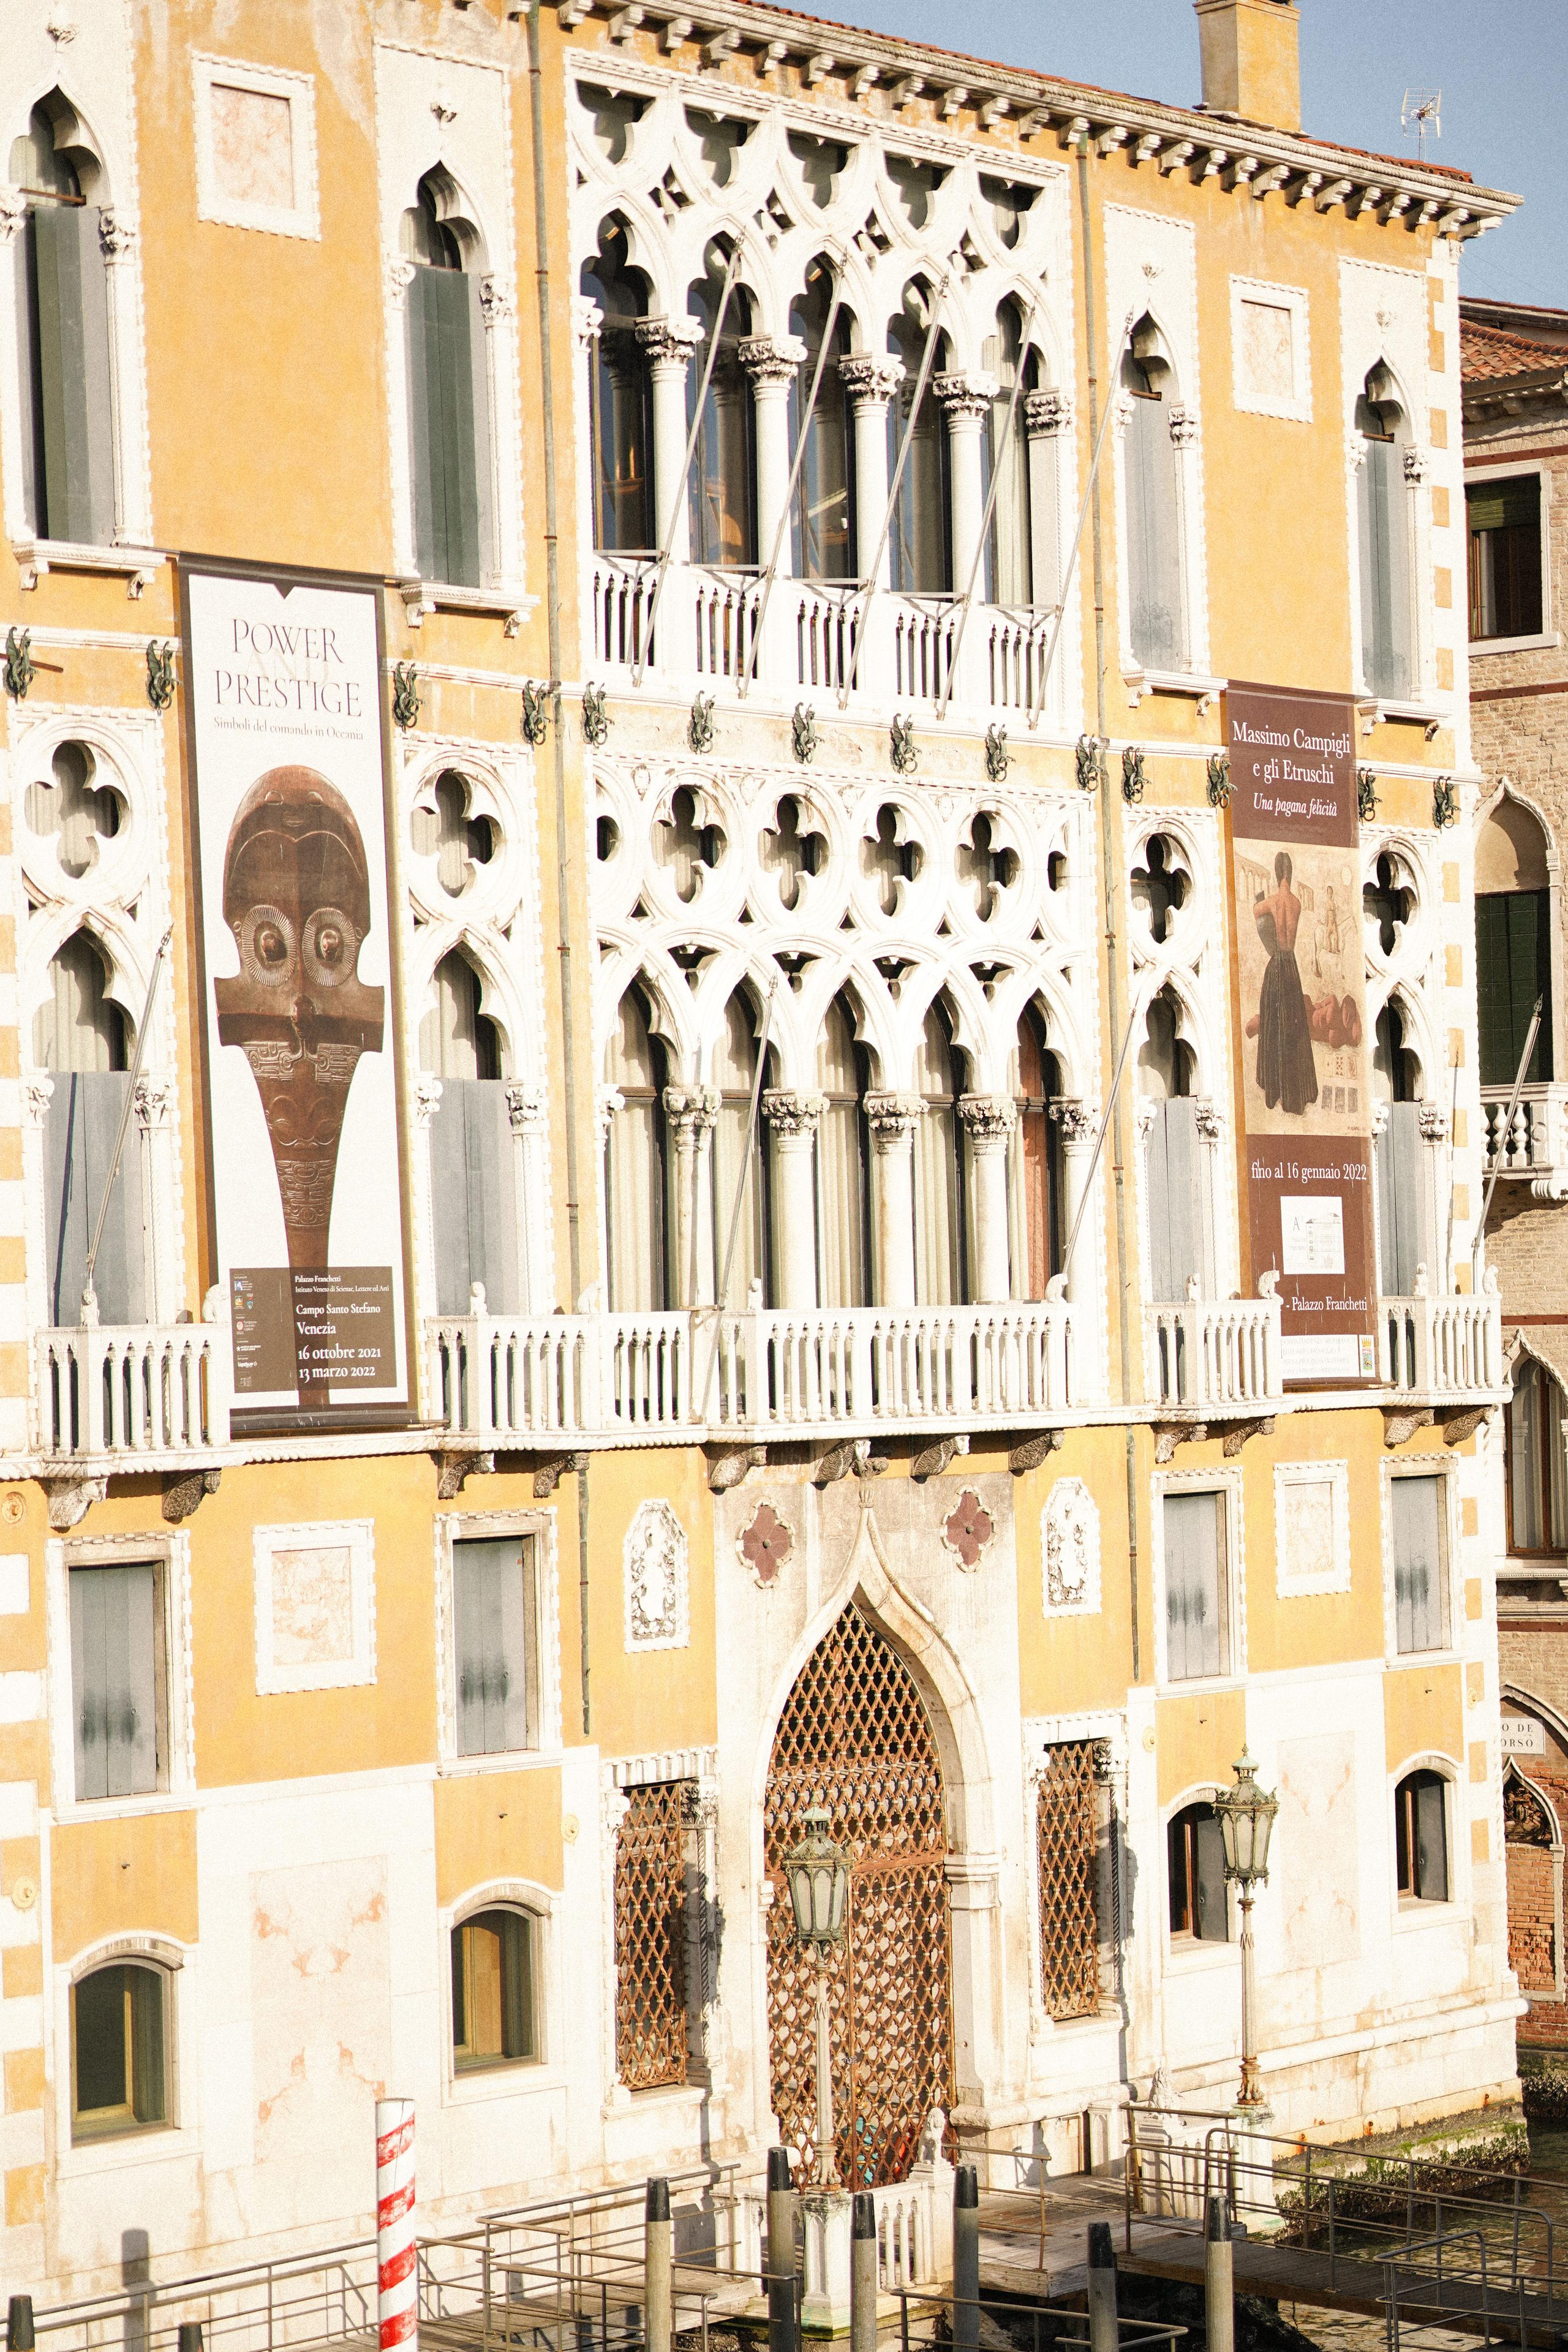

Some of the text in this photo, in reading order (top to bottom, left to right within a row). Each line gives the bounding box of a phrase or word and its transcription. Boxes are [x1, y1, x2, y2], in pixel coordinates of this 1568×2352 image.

[231, 619, 344, 663] POWER
[213, 670, 362, 717] PRESTIGE
[214, 717, 363, 740] Simboli del comando in Oceania
[1232, 720, 1351, 759] Massimo Campigli
[1253, 758, 1334, 785] e gli Etruschi
[1253, 793, 1337, 819] Una pagana felicità
[1251, 1161, 1366, 1184] fino al 16 gennaio 2022
[296, 1302, 381, 1317] Campo Santo Stefano
[1292, 1296, 1324, 1311] Palazzo
[1325, 1296, 1367, 1311] Franchetti
[296, 1322, 336, 1335] Venezia
[298, 1343, 382, 1360] 16 ottobre 2021
[299, 1366, 375, 1383] 13 marzo 2022
[1518, 1724, 1533, 1732] DE
